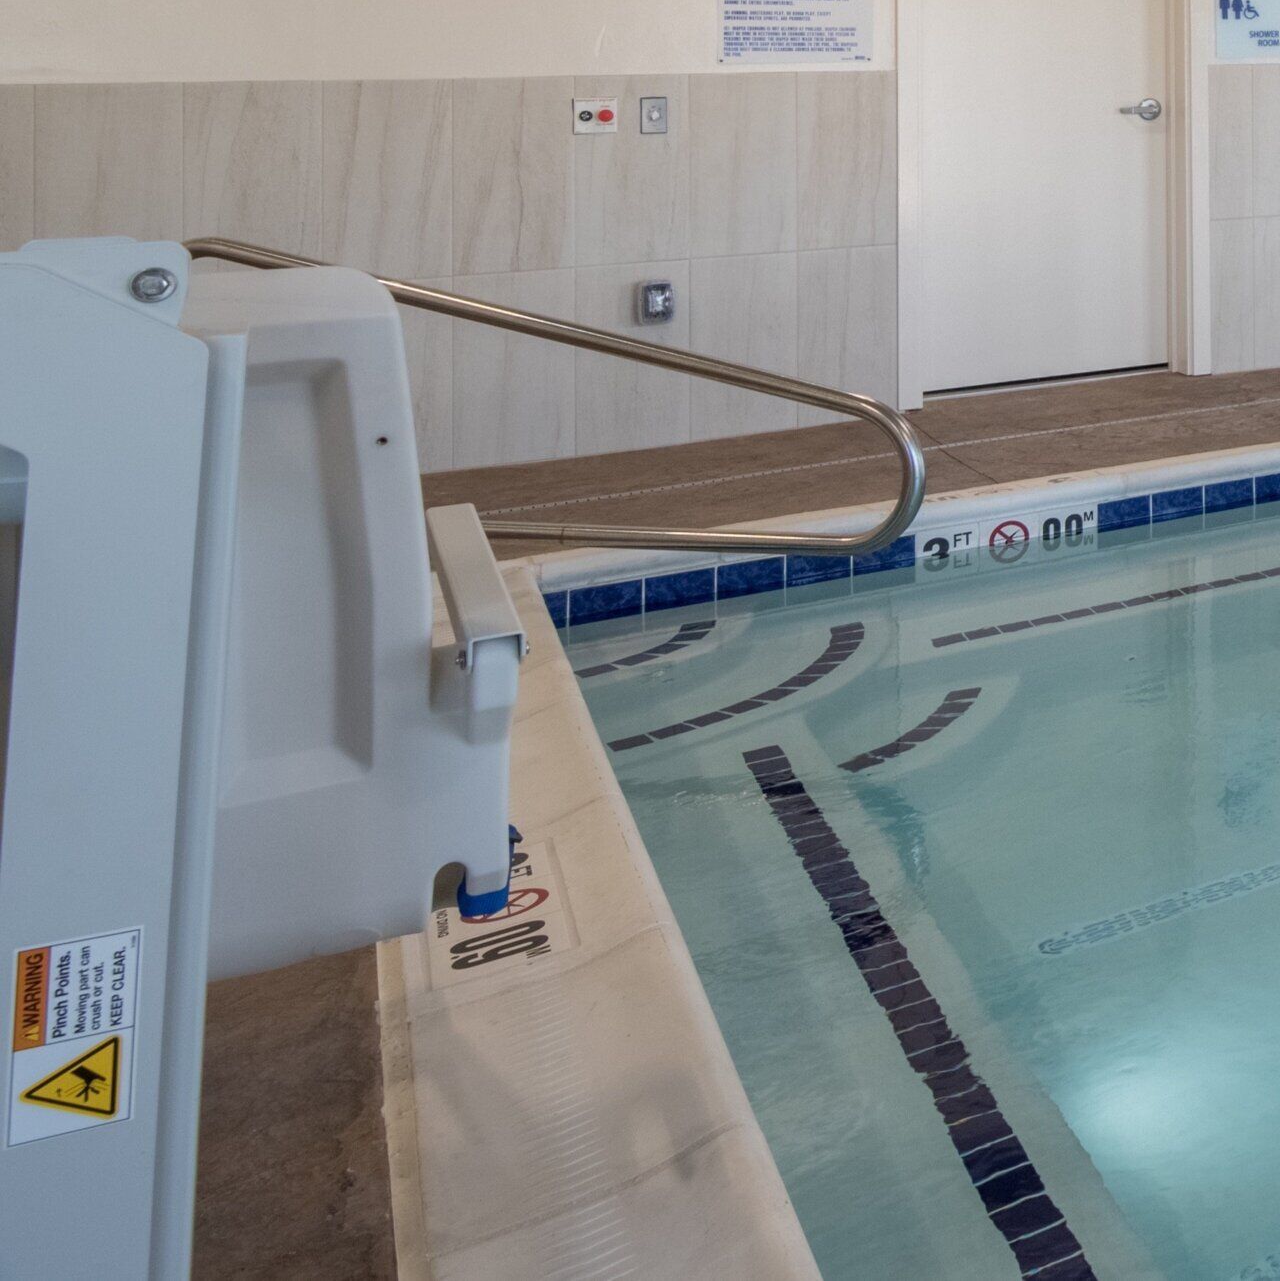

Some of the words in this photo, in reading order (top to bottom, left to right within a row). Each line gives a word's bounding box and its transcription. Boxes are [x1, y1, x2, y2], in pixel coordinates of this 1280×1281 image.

[1249, 30, 1280, 38] SHOWER
[1257, 39, 1280, 47] ROOM
[1083, 511, 1094, 522] M
[953, 531, 973, 548] FT
[81, 945, 91, 967] can
[112, 945, 127, 991] CLEAR.
[54, 950, 72, 999] Points.
[78, 967, 91, 991] part
[92, 961, 105, 983] cut.
[22, 952, 44, 1029] WARNING
[93, 985, 103, 998] or
[52, 999, 69, 1039] Pinch
[74, 992, 91, 1034] Moving
[90, 998, 102, 1031] crush
[110, 997, 124, 1027] KEEP
